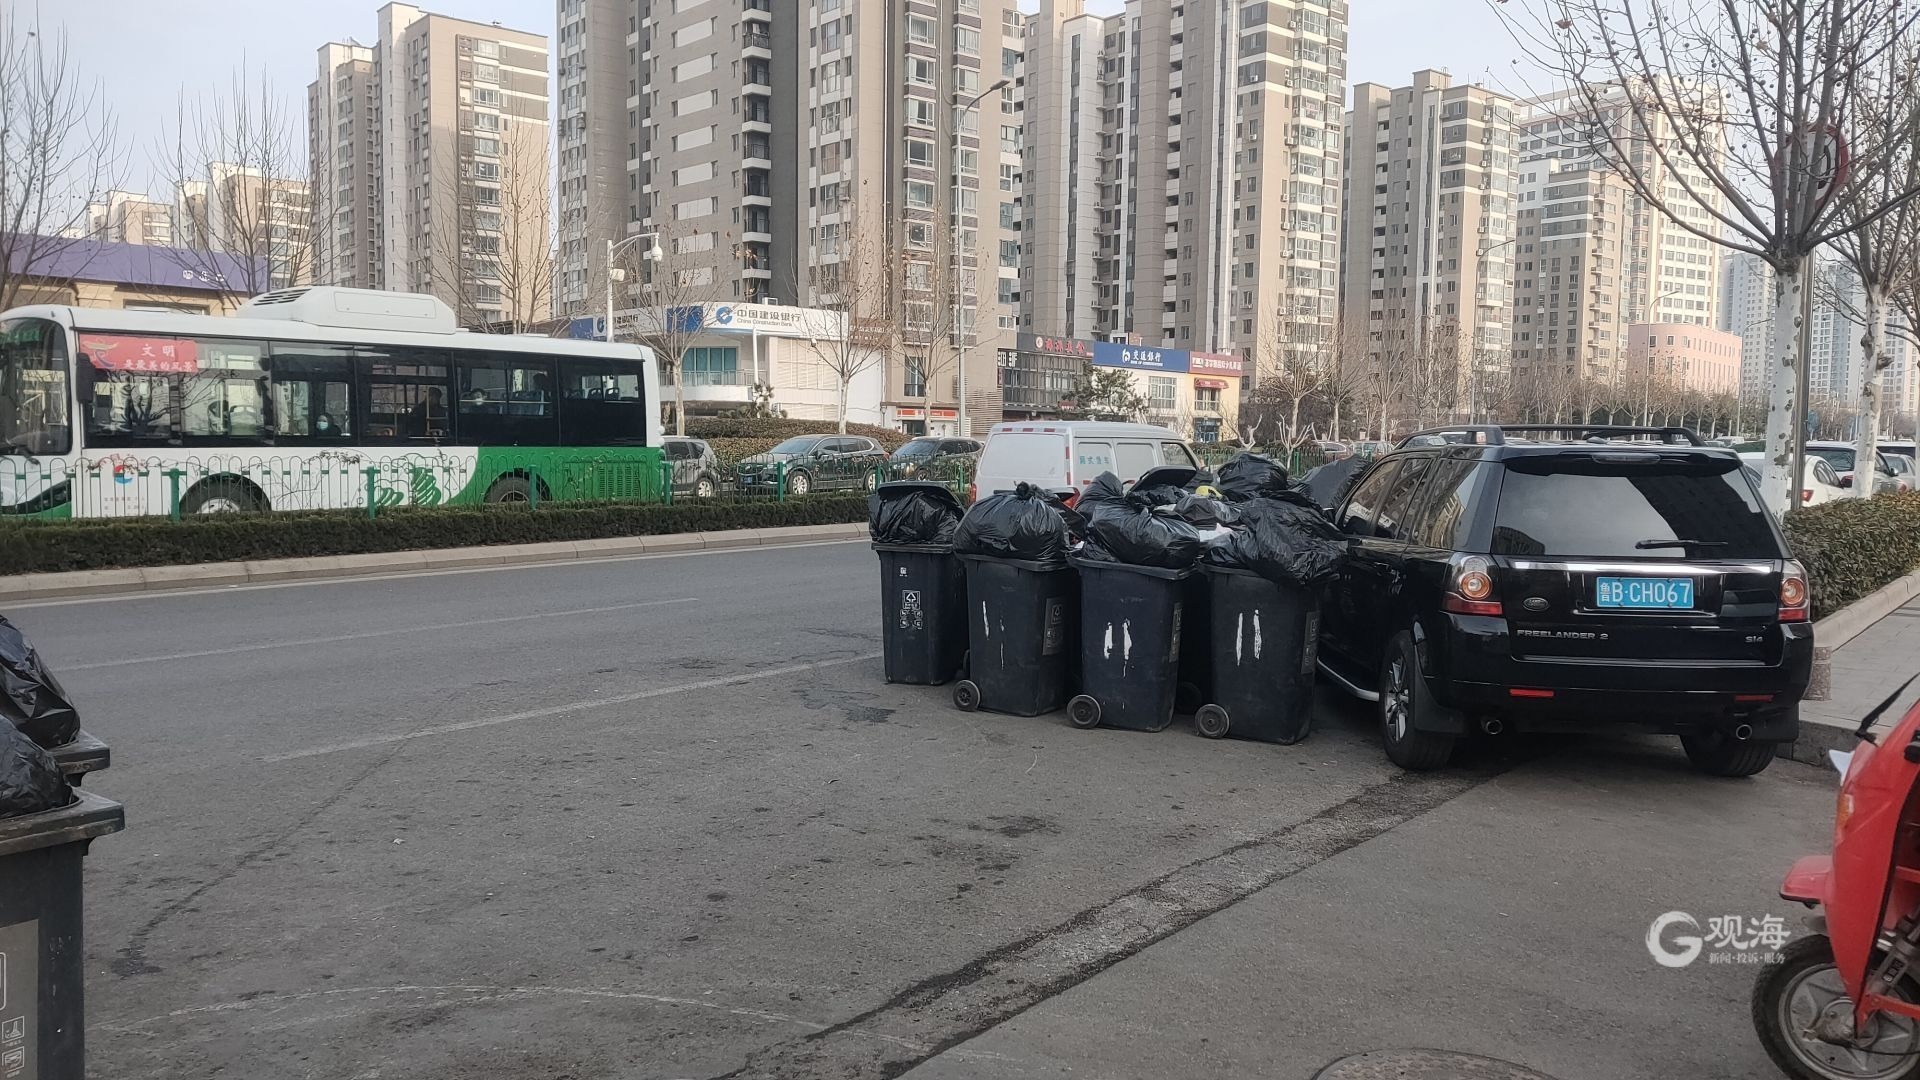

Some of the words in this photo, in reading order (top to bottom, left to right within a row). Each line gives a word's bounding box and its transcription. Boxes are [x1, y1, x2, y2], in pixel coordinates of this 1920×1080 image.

[737, 309, 800, 322] 中国建设银行
[141, 344, 175, 357] 文明
[1600, 581, 1691, 604] 鲁B·CH067
[1517, 629, 1596, 640] FREELANDER
